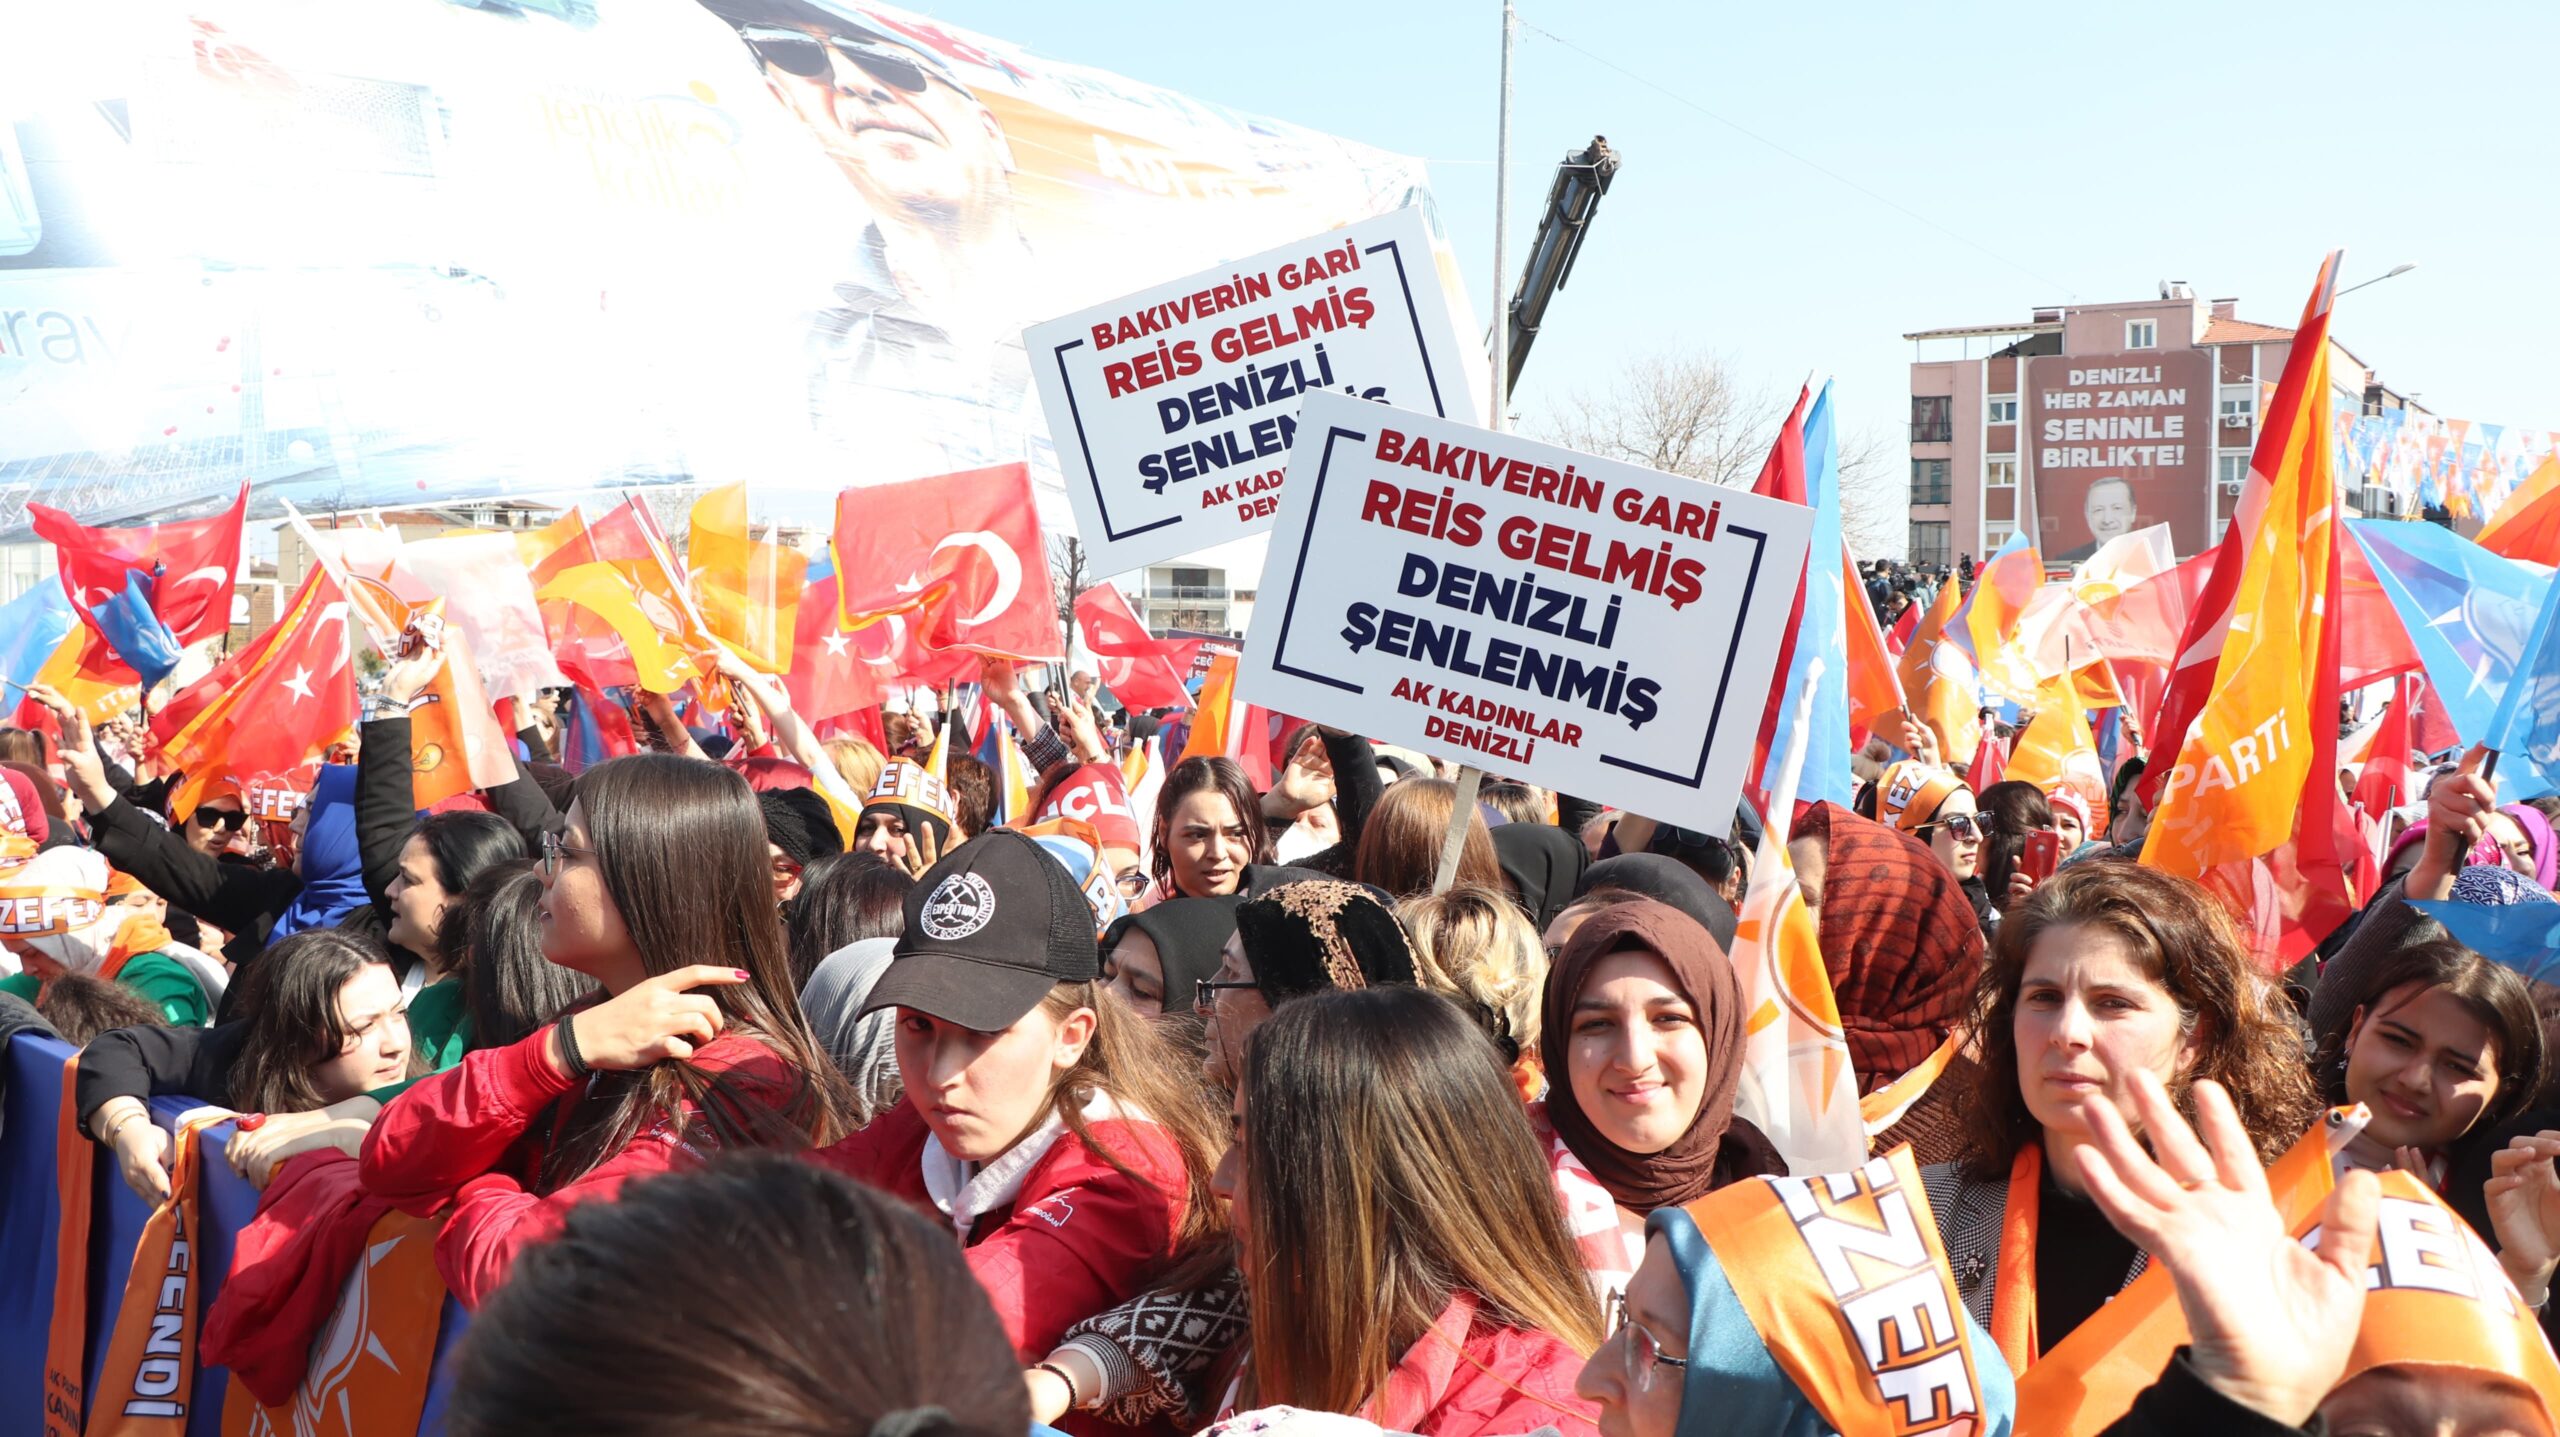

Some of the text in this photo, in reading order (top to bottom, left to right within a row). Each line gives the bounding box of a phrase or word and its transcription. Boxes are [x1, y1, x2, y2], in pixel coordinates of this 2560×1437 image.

[1091, 238, 1361, 351] BAKIVERİN GARİ
[1103, 286, 1375, 399] REİS GELMİŞ
[1157, 343, 1335, 434] DENİZLİ
[2044, 388, 2186, 409] HER ZAMAN
[1202, 483, 1233, 509] AK
[1375, 428, 1721, 542] BAKIVERİN GARİ
[1361, 479, 1706, 611] REİS GELMİŞ
[1397, 552, 1622, 649] DENİZLİ
[1340, 601, 1662, 731] ŞENLENMİŞ
[1391, 677, 1582, 748] AK KADINLAR
[1424, 715, 1535, 765] DENİZLİ
